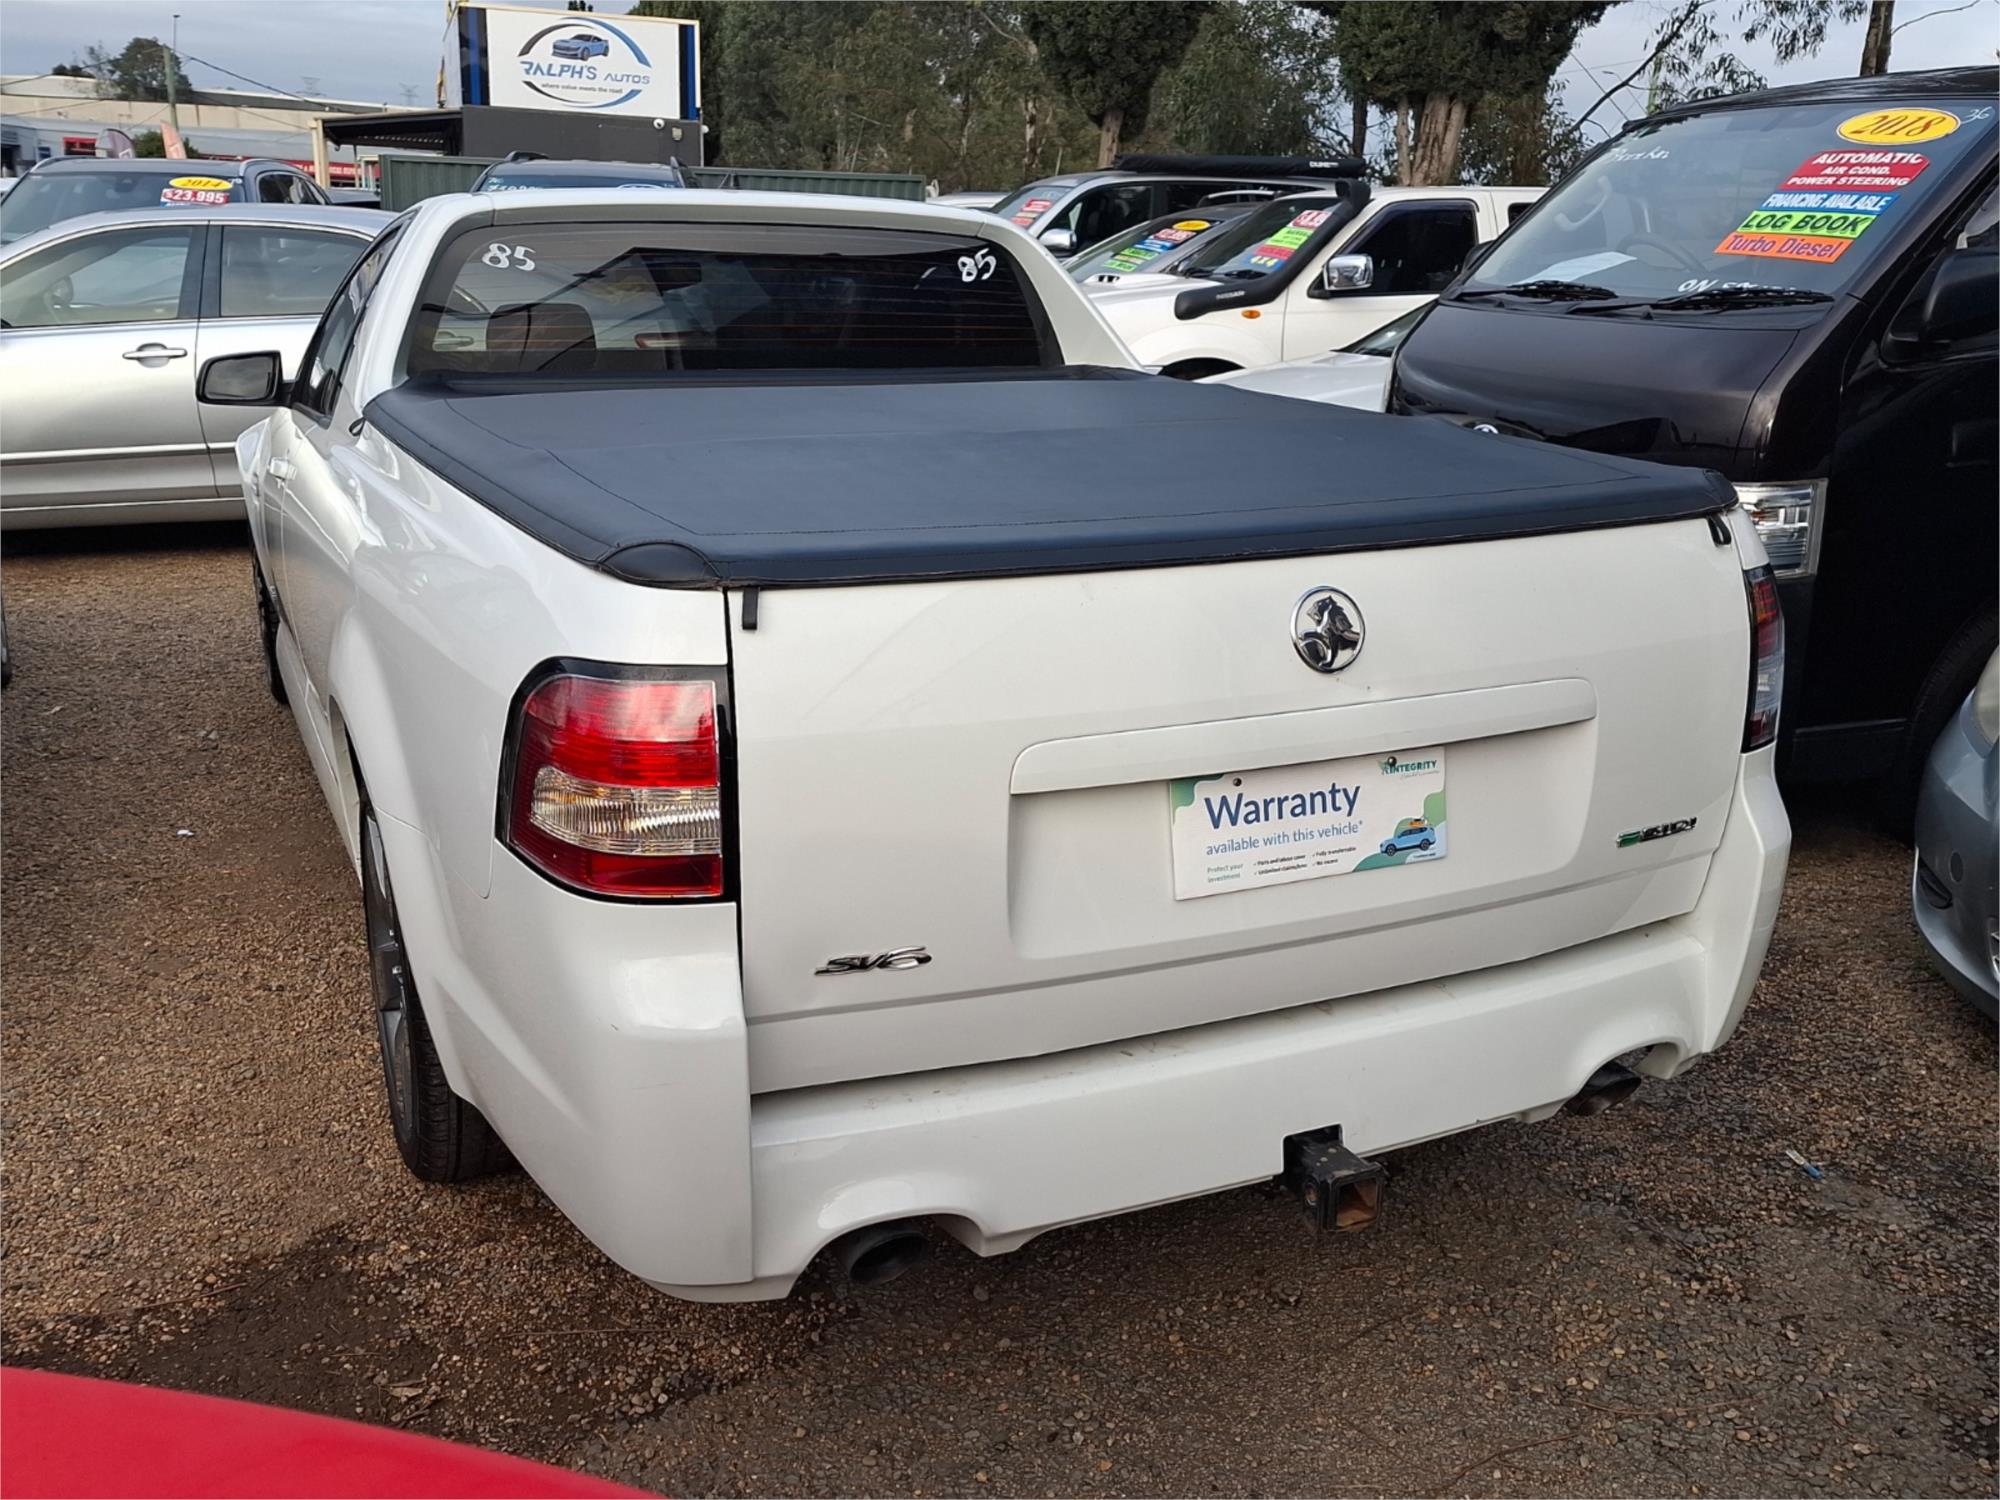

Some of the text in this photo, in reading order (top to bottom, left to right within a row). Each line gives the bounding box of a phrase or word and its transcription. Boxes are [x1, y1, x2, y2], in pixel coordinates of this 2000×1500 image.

[520, 61, 650, 84] RALPH'S AUTOS
[1851, 114, 1946, 137] 2018
[1812, 152, 1923, 165] AUTOMATIC
[1787, 177, 1910, 187] POWER STEERING
[1821, 167, 1890, 175] AIR COND.
[164, 189, 225, 204] $23,995
[1762, 193, 1891, 211] FINANCING AVAILABLE
[1742, 214, 1869, 233] LOG BOOK
[482, 243, 536, 271] 85
[1726, 235, 1844, 258] Turbo Diesel
[957, 248, 996, 282] 85
[1390, 760, 1437, 774] INTEGRITY
[1204, 782, 1361, 830] Warranty
[1206, 836, 1260, 856] available
[1263, 831, 1290, 846] with
[1292, 827, 1315, 842] this
[814, 945, 932, 976] SV6
